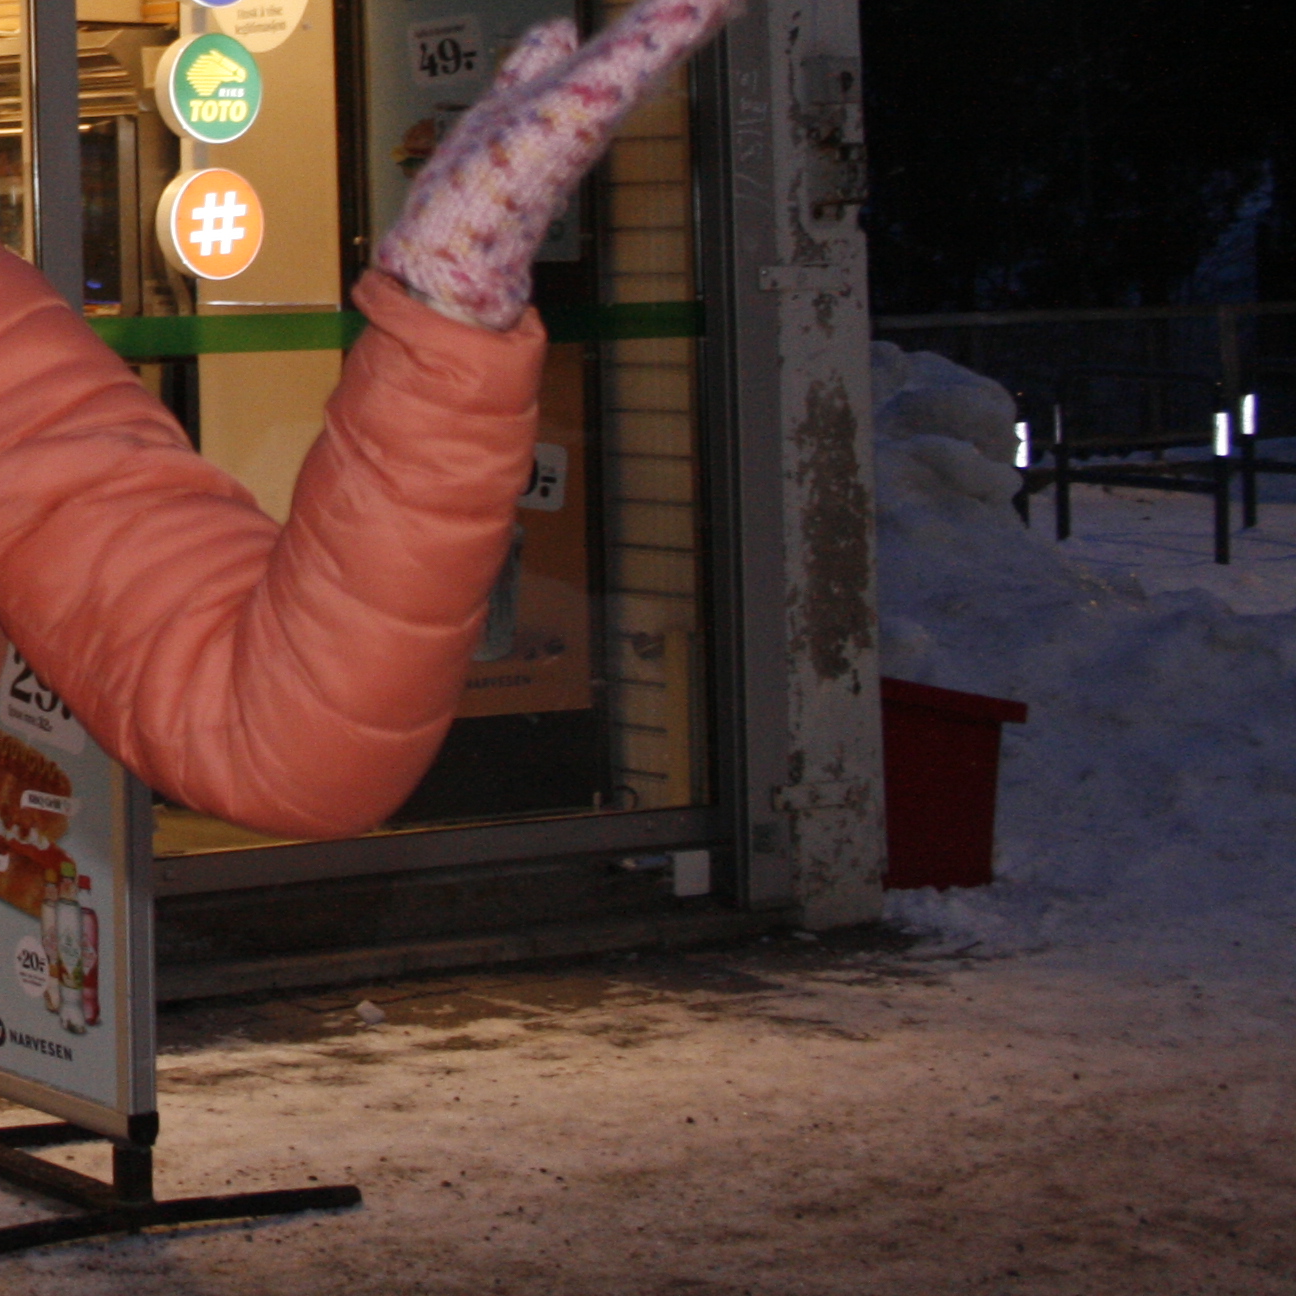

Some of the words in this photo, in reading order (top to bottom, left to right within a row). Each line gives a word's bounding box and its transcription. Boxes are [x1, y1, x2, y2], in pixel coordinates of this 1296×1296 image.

[218, 87, 245, 98] RIKS
[189, 99, 248, 123] TOTO
[9, 1029, 73, 1062] NARVESEN
